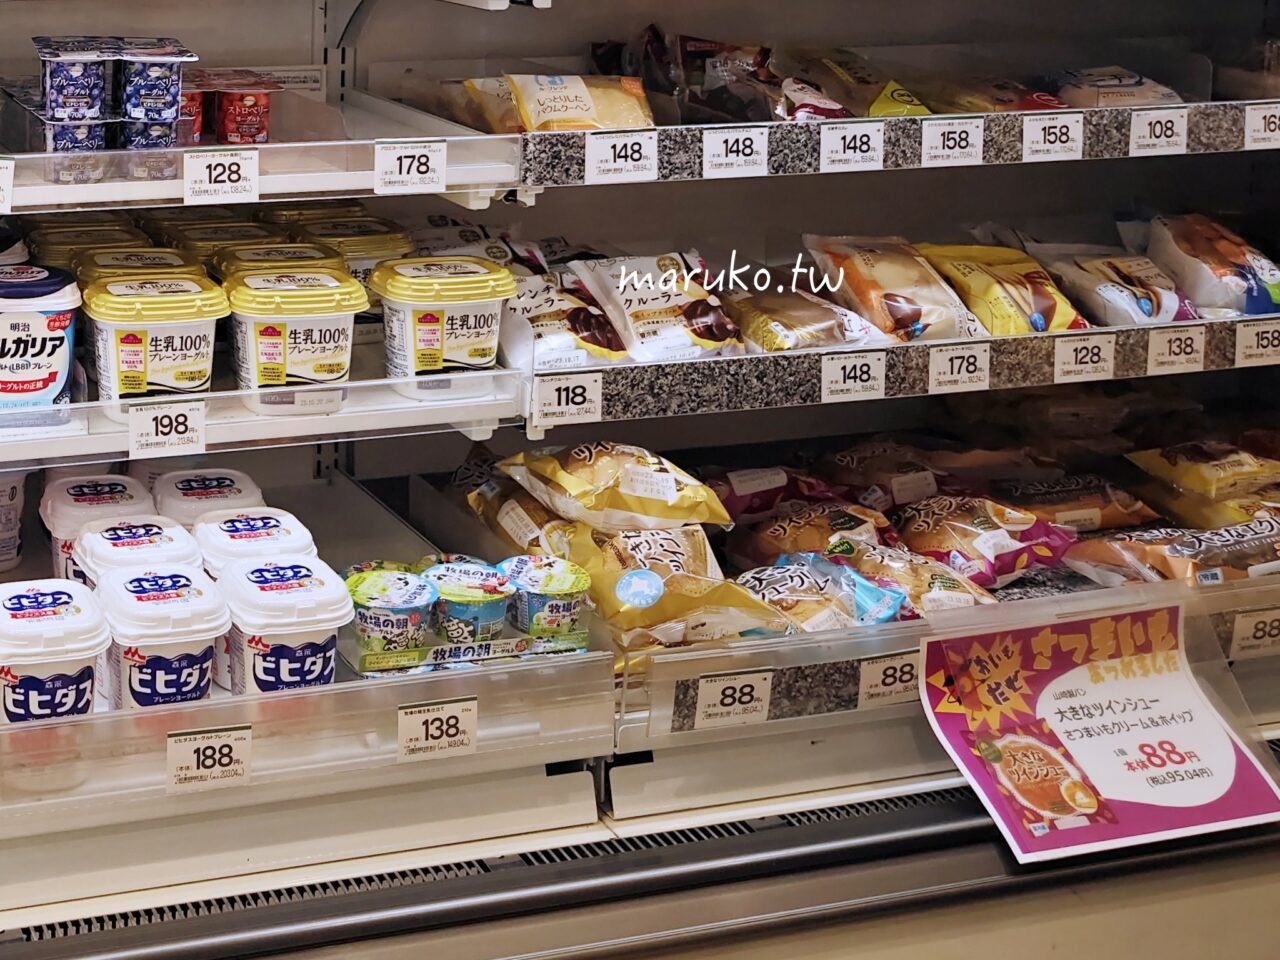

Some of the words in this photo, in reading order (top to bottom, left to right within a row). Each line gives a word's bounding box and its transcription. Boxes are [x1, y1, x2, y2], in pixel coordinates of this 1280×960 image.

[255, 652, 336, 684] ビヒダス
[431, 644, 490, 662] 牧場の朝
[5, 677, 93, 712] ビヒダス
[130, 662, 212, 696] ビヒダス
[1055, 698, 1159, 722] 大きなツインシュー
